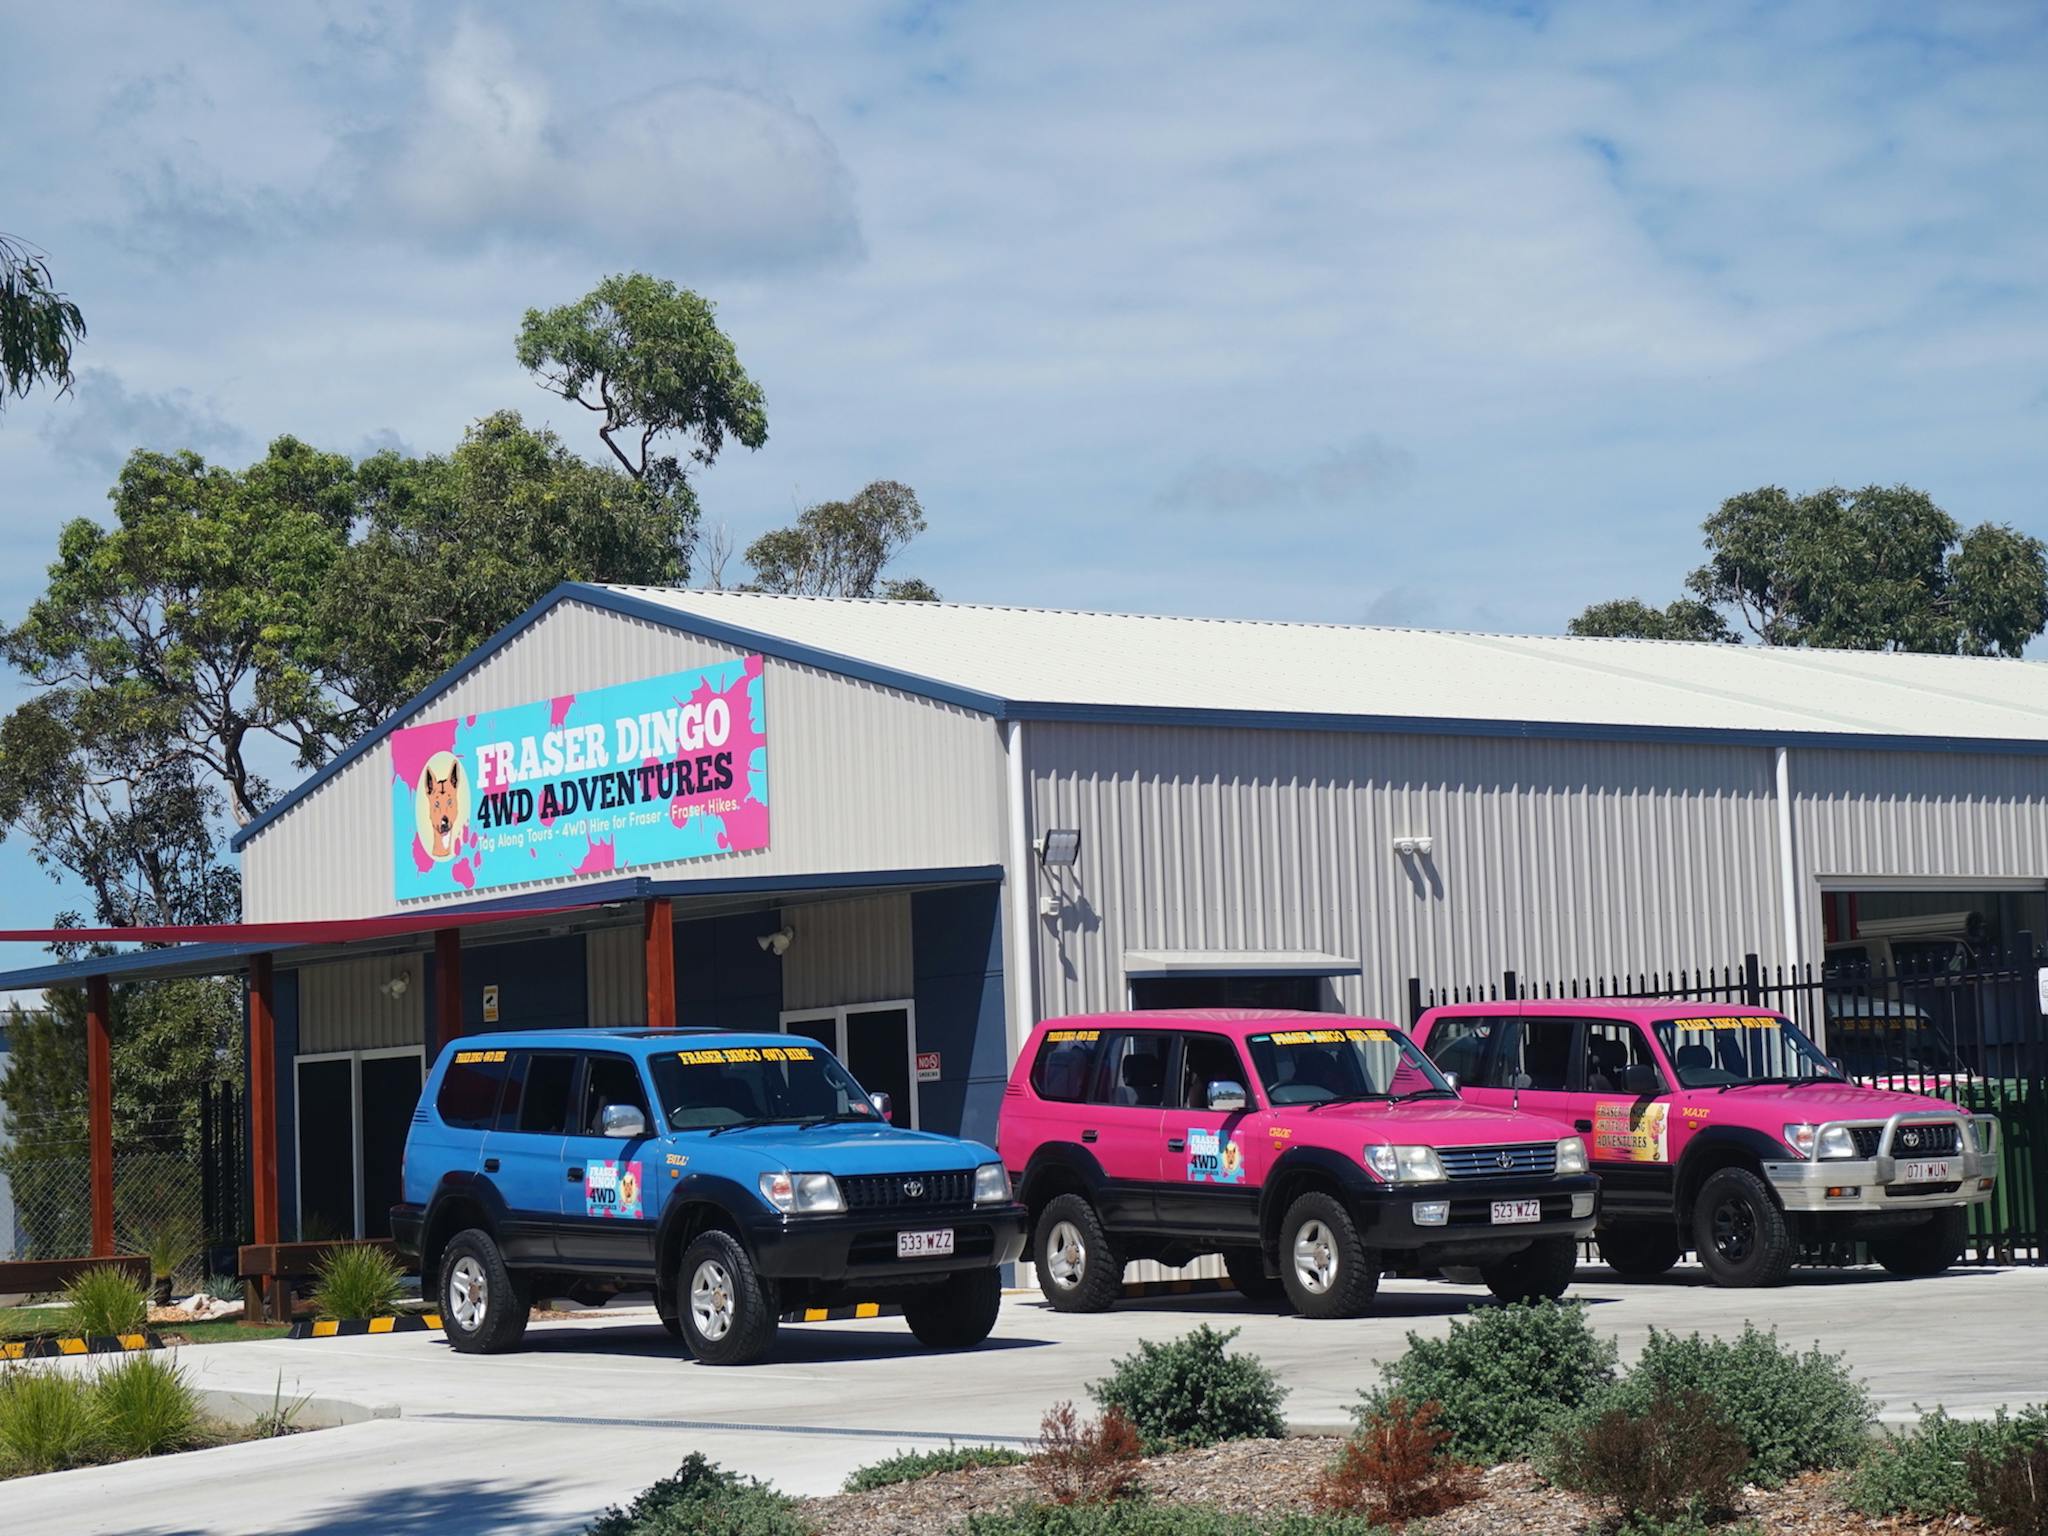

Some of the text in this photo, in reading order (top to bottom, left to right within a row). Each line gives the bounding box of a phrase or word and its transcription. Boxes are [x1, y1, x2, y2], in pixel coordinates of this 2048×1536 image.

[475, 698, 731, 789] FRASER DINGO
[477, 751, 733, 829] 4WD ADVENTURES
[478, 835, 495, 852] Tag
[498, 831, 524, 849] Along
[527, 826, 553, 842] Tours
[562, 820, 587, 837] 4WD
[589, 818, 610, 833] Hire
[612, 814, 626, 829] for
[629, 811, 661, 828] Fraser
[671, 804, 705, 820] Fraser
[708, 799, 740, 814] Hikes.
[678, 1048, 814, 1065] FRASER DINGO 4WD HIRE
[918, 1056, 930, 1068] NO
[1597, 1135, 1647, 1148] ADVENTURES
[1190, 1144, 1218, 1155] DINGO
[1191, 1155, 1218, 1169] 4WD
[589, 1176, 616, 1188] DINGO
[590, 1188, 616, 1204] 4WD
